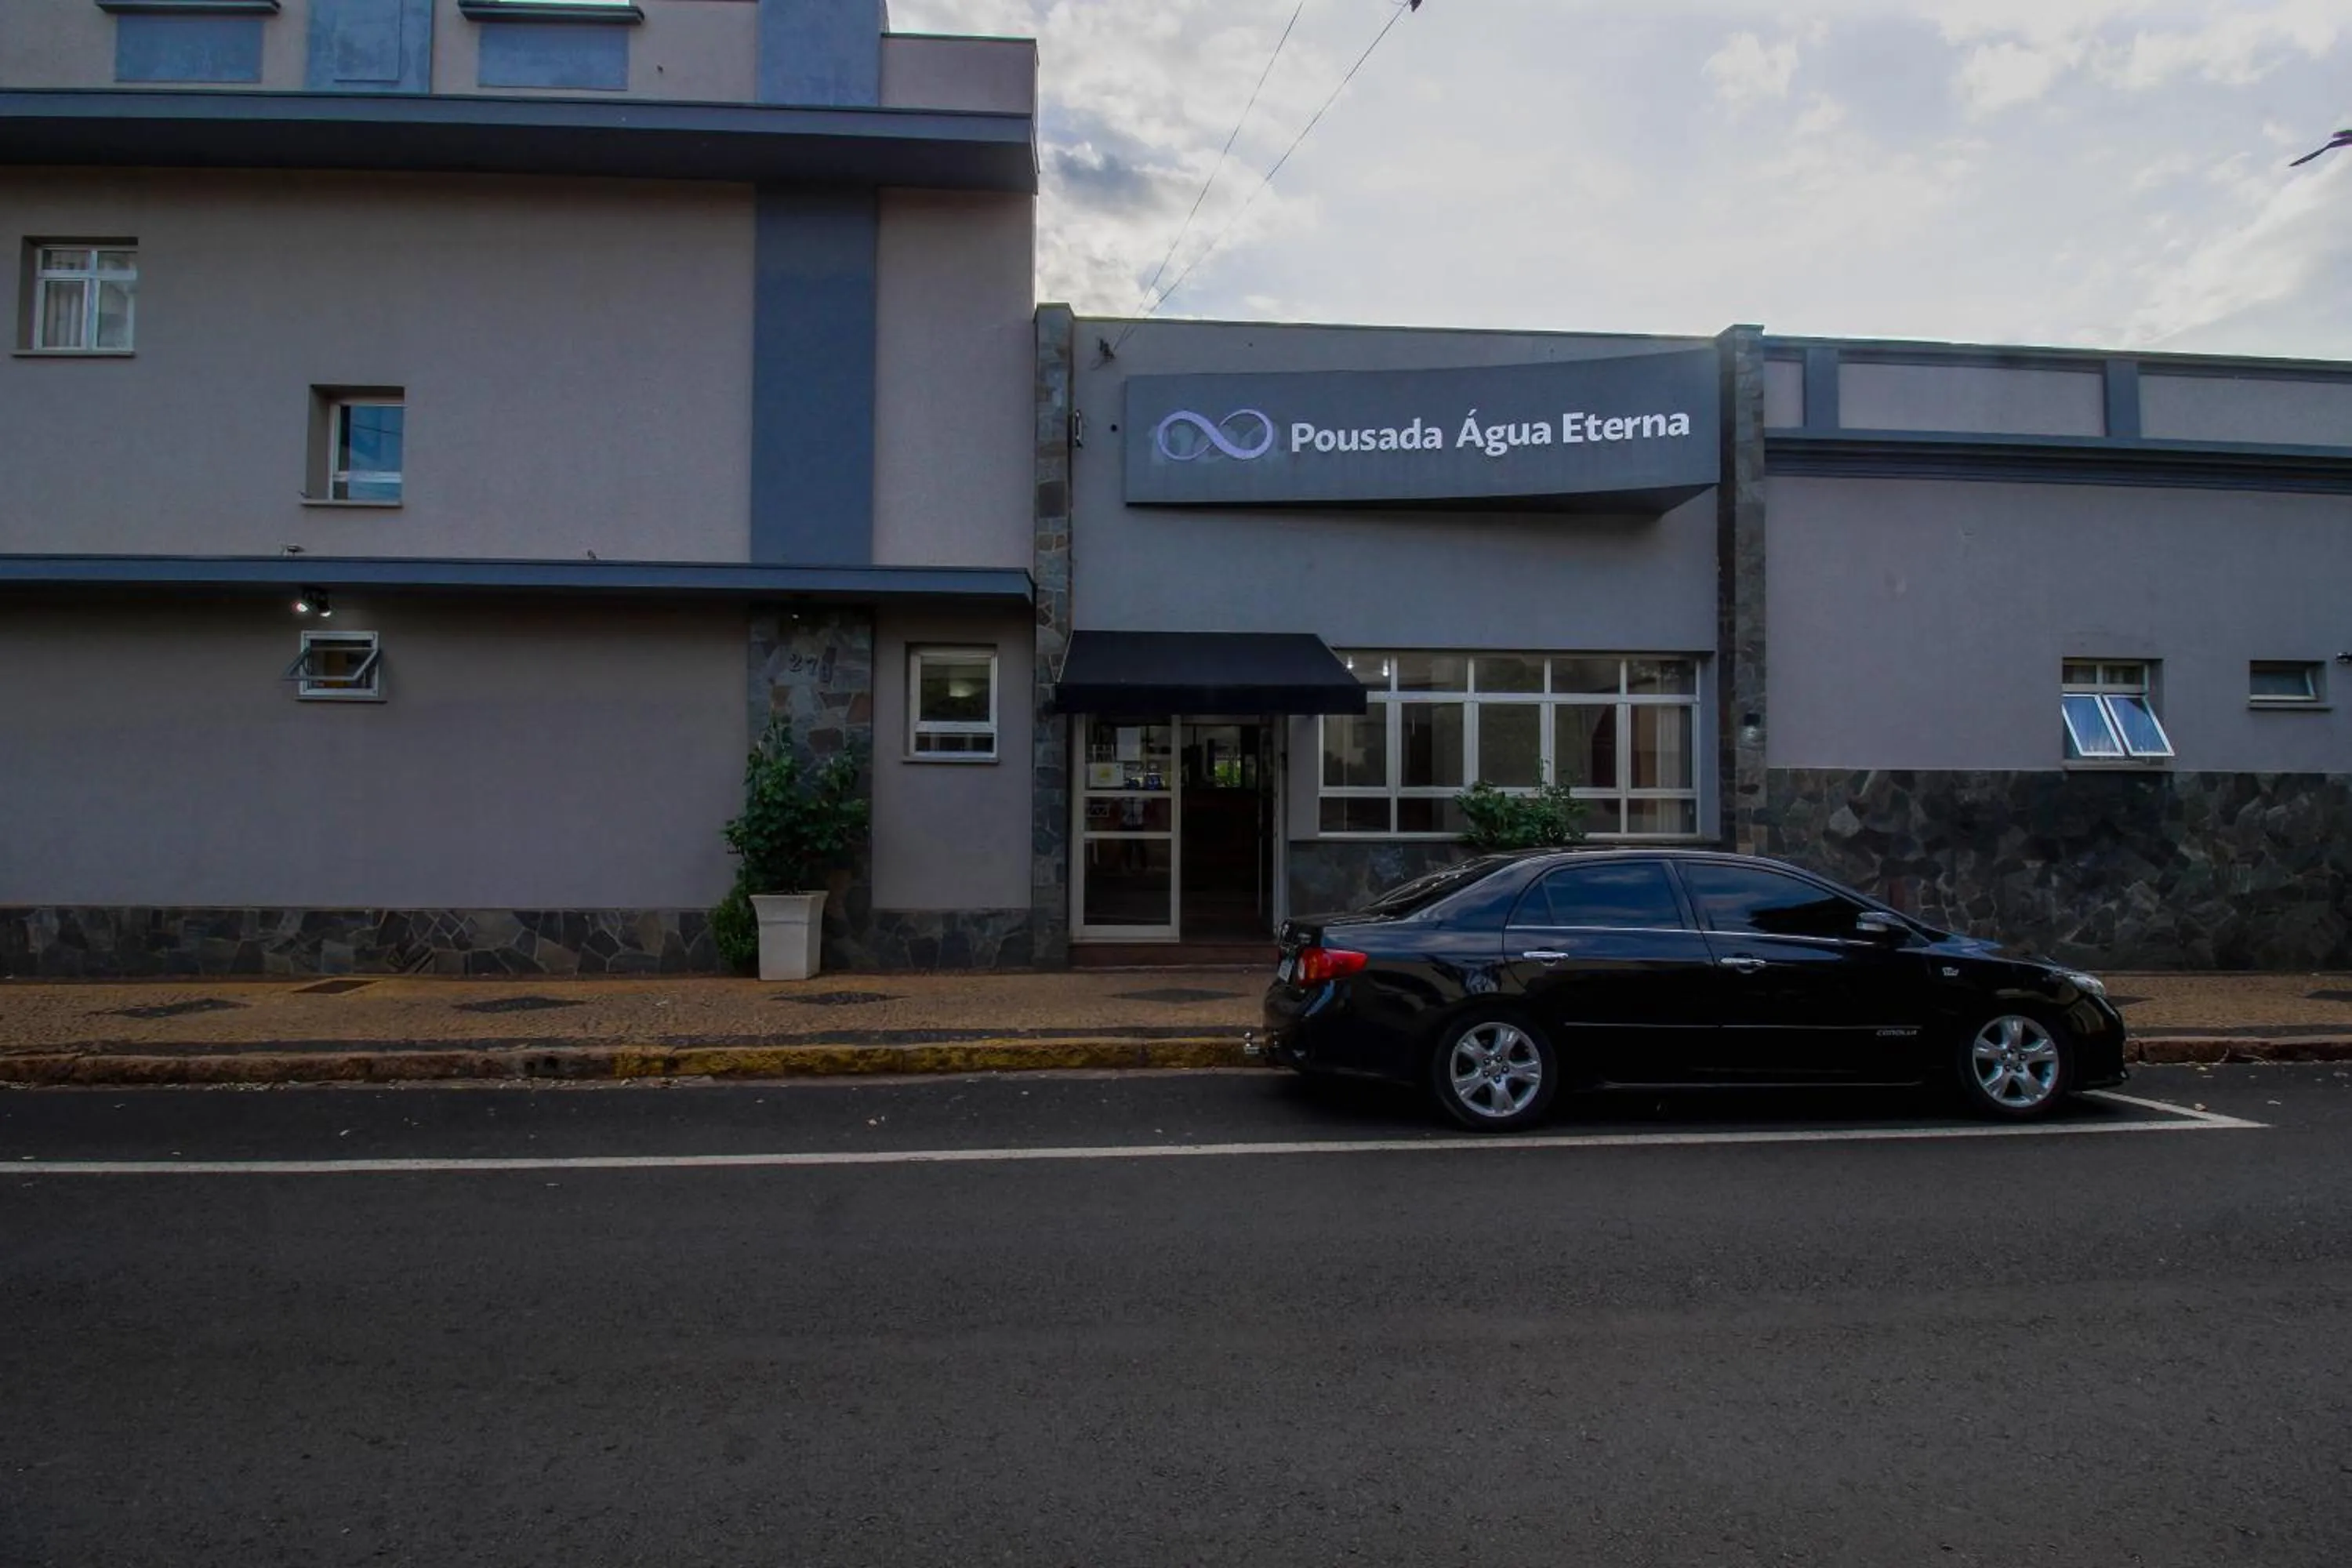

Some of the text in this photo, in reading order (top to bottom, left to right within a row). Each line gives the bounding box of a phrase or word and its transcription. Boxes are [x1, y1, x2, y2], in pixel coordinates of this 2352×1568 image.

[1291, 408, 1690, 457] Pousada Água Eterna
